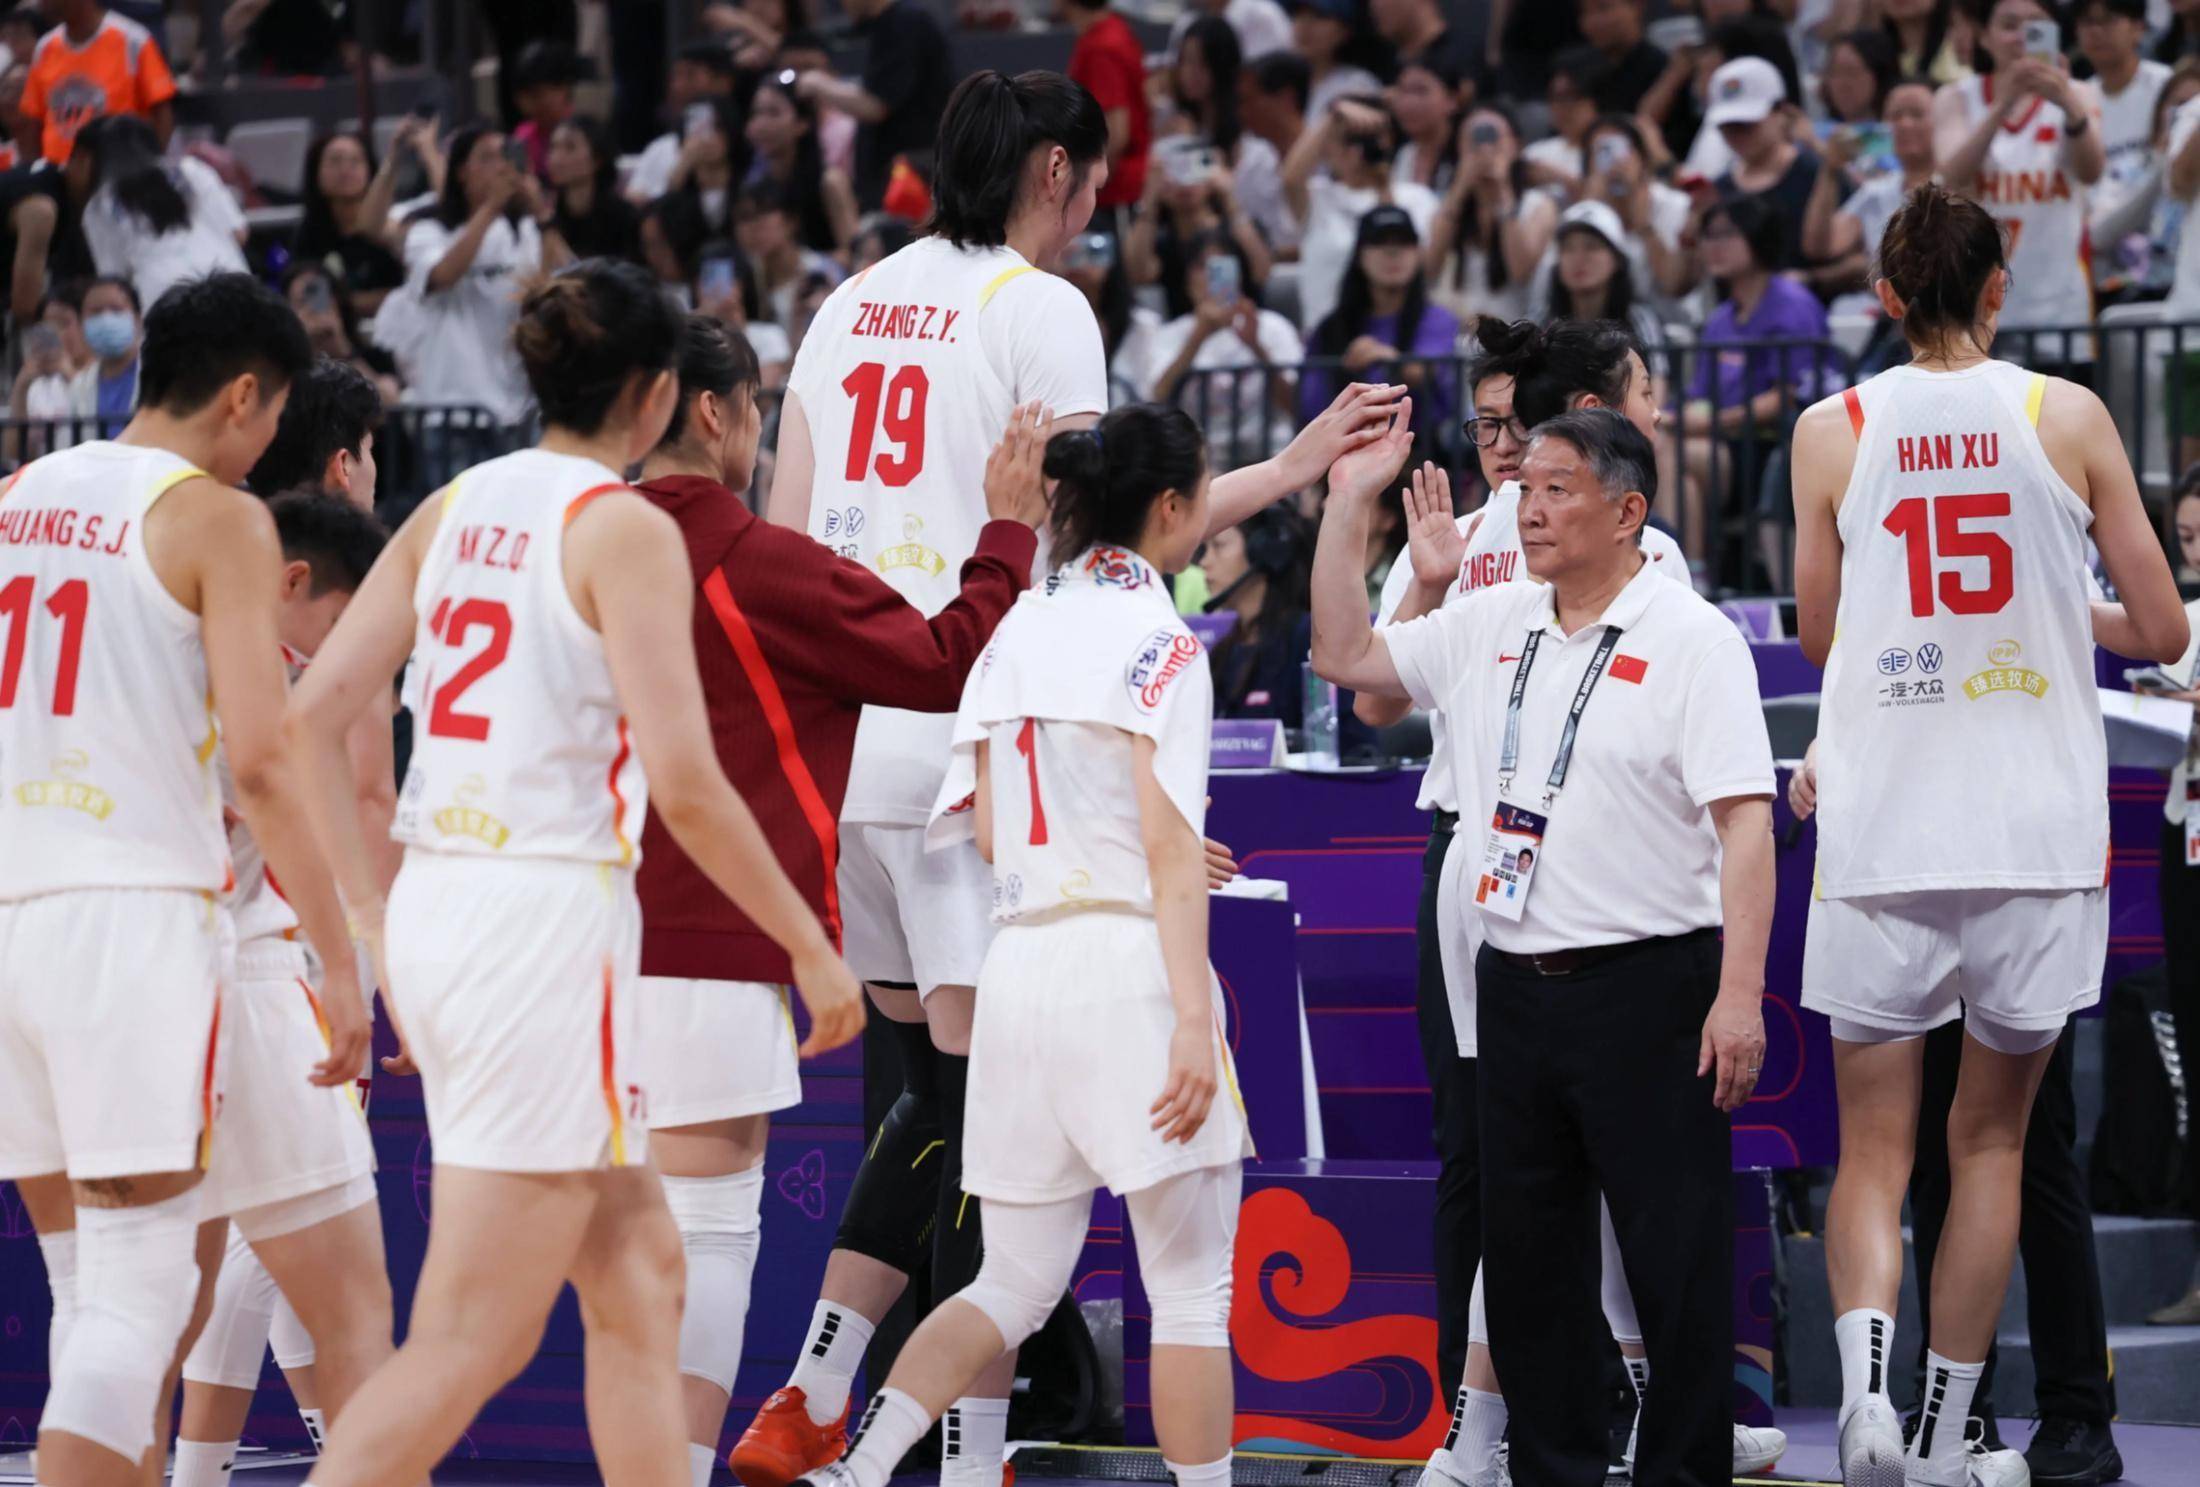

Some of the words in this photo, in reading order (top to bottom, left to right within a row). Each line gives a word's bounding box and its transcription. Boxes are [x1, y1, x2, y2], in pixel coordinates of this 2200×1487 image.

[1975, 169, 2070, 202] HINA
[852, 302, 918, 339] ZHANG
[841, 362, 929, 487] 19
[1897, 434, 1953, 472] HAN
[1961, 433, 1999, 468] XU
[1882, 492, 2014, 618] 15
[0, 575, 89, 716] 11
[1016, 716, 1048, 846] 1
